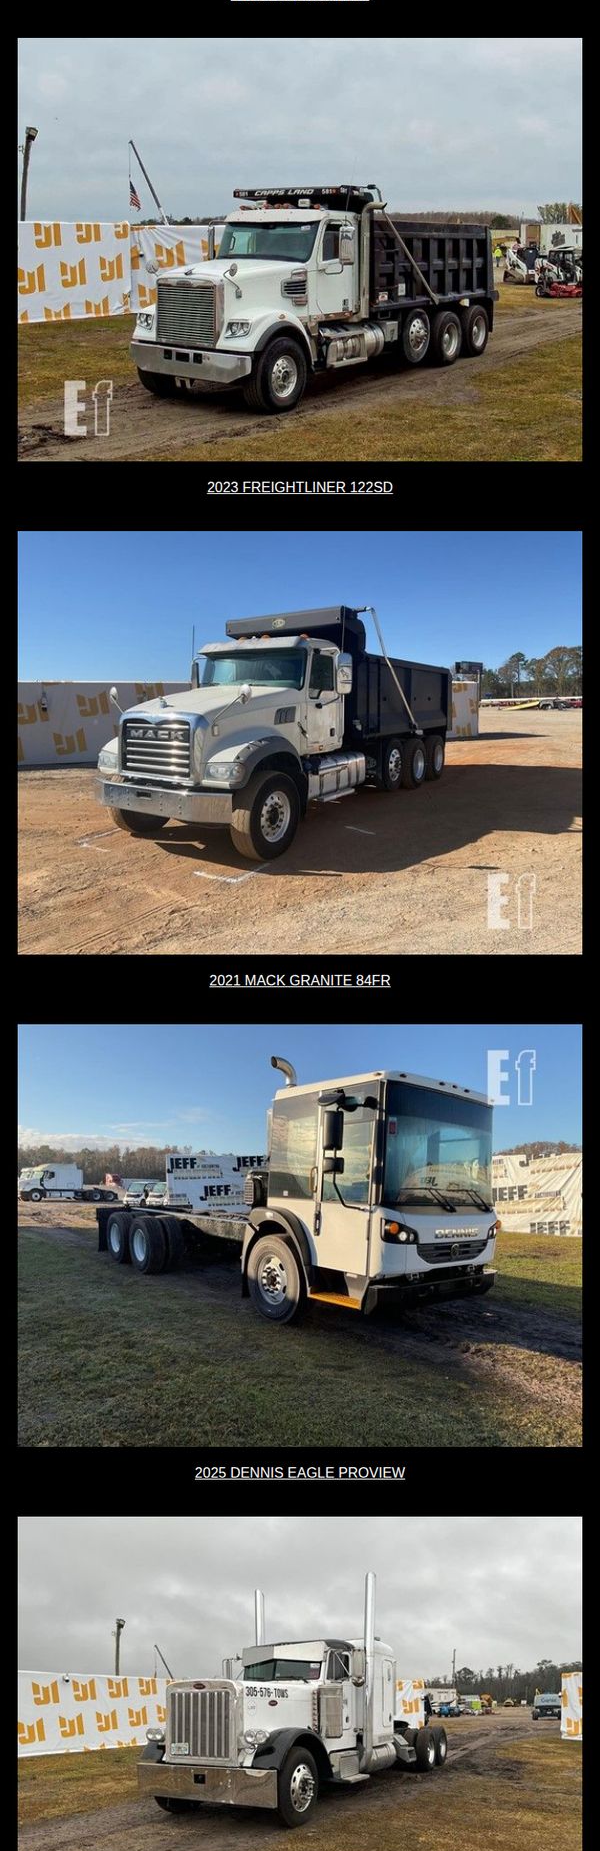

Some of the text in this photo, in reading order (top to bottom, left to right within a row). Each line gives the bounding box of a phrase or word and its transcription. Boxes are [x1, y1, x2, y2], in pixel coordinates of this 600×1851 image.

[130, 729, 185, 740] MACK
[167, 1157, 197, 1173] JEFF
[232, 1156, 264, 1172] JEFF
[200, 1185, 231, 1201] JEFF
[435, 1228, 479, 1239] DENNIS
